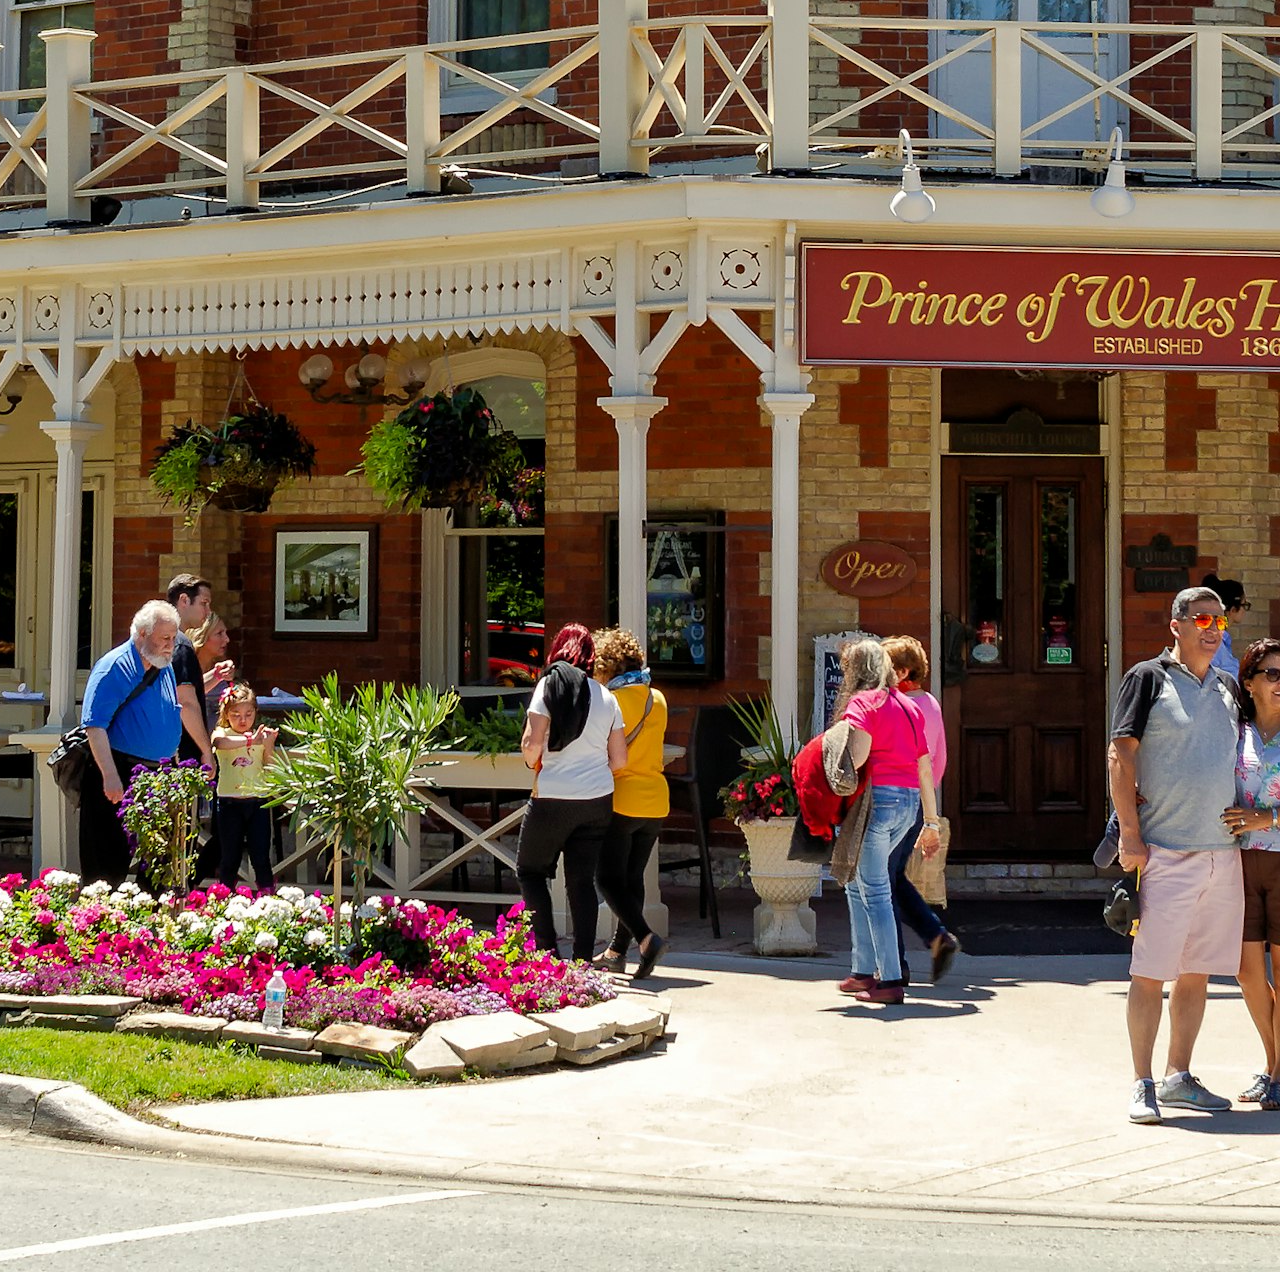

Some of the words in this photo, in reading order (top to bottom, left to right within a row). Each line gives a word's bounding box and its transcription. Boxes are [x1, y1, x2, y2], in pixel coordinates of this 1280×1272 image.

[840, 271, 1007, 326] Prince
[1016, 272, 1079, 343] of
[1076, 274, 1236, 338] Wales
[1093, 336, 1204, 355] ESTABLISHED
[834, 550, 907, 588] Open
